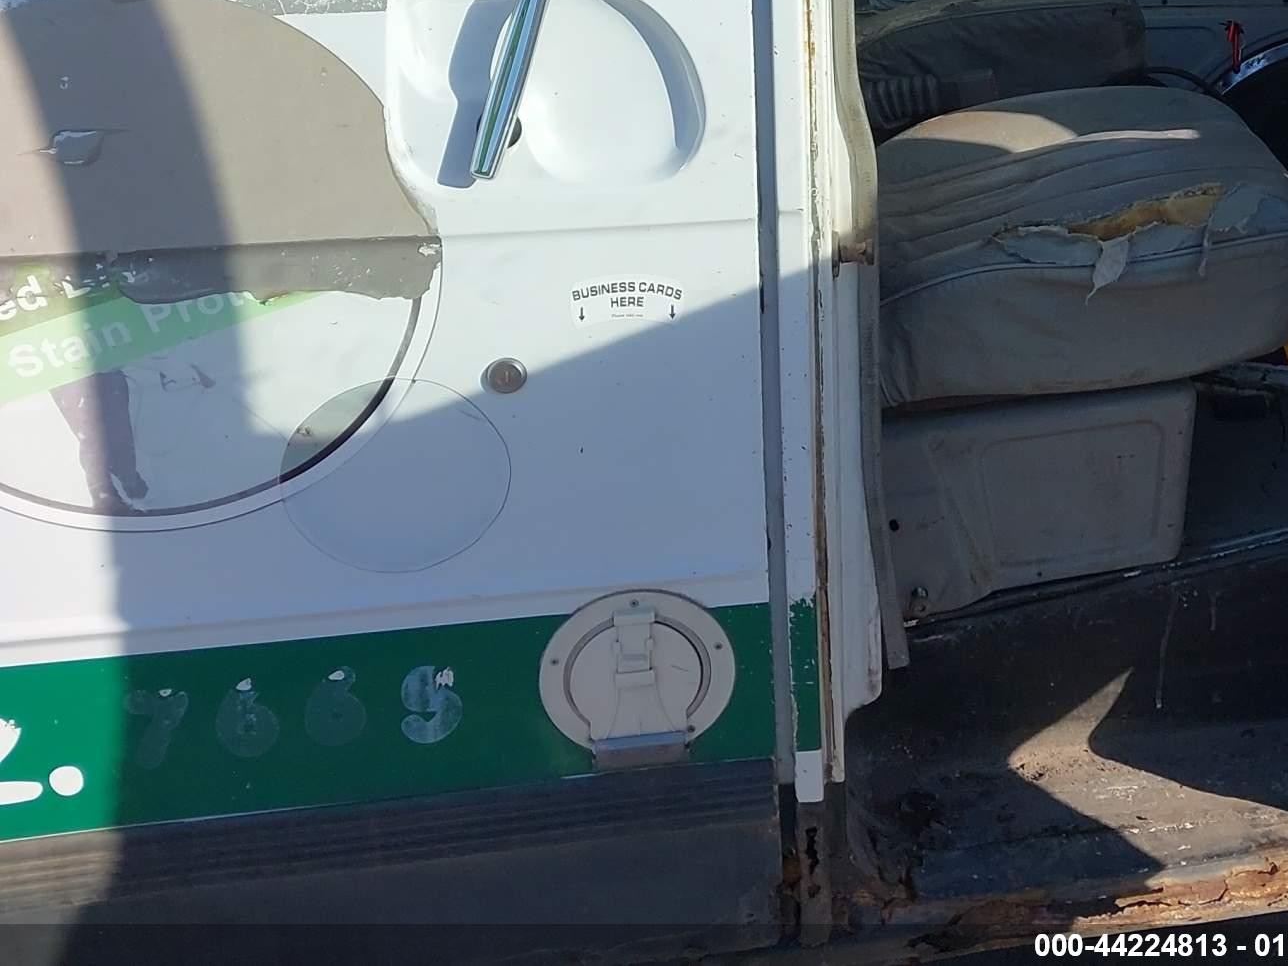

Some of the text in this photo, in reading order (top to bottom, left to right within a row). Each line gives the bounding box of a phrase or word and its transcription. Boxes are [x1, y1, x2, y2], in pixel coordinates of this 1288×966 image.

[572, 281, 683, 302] BUSINESS CARDS
[610, 296, 645, 308] HERE
[8, 321, 132, 378] Stain
